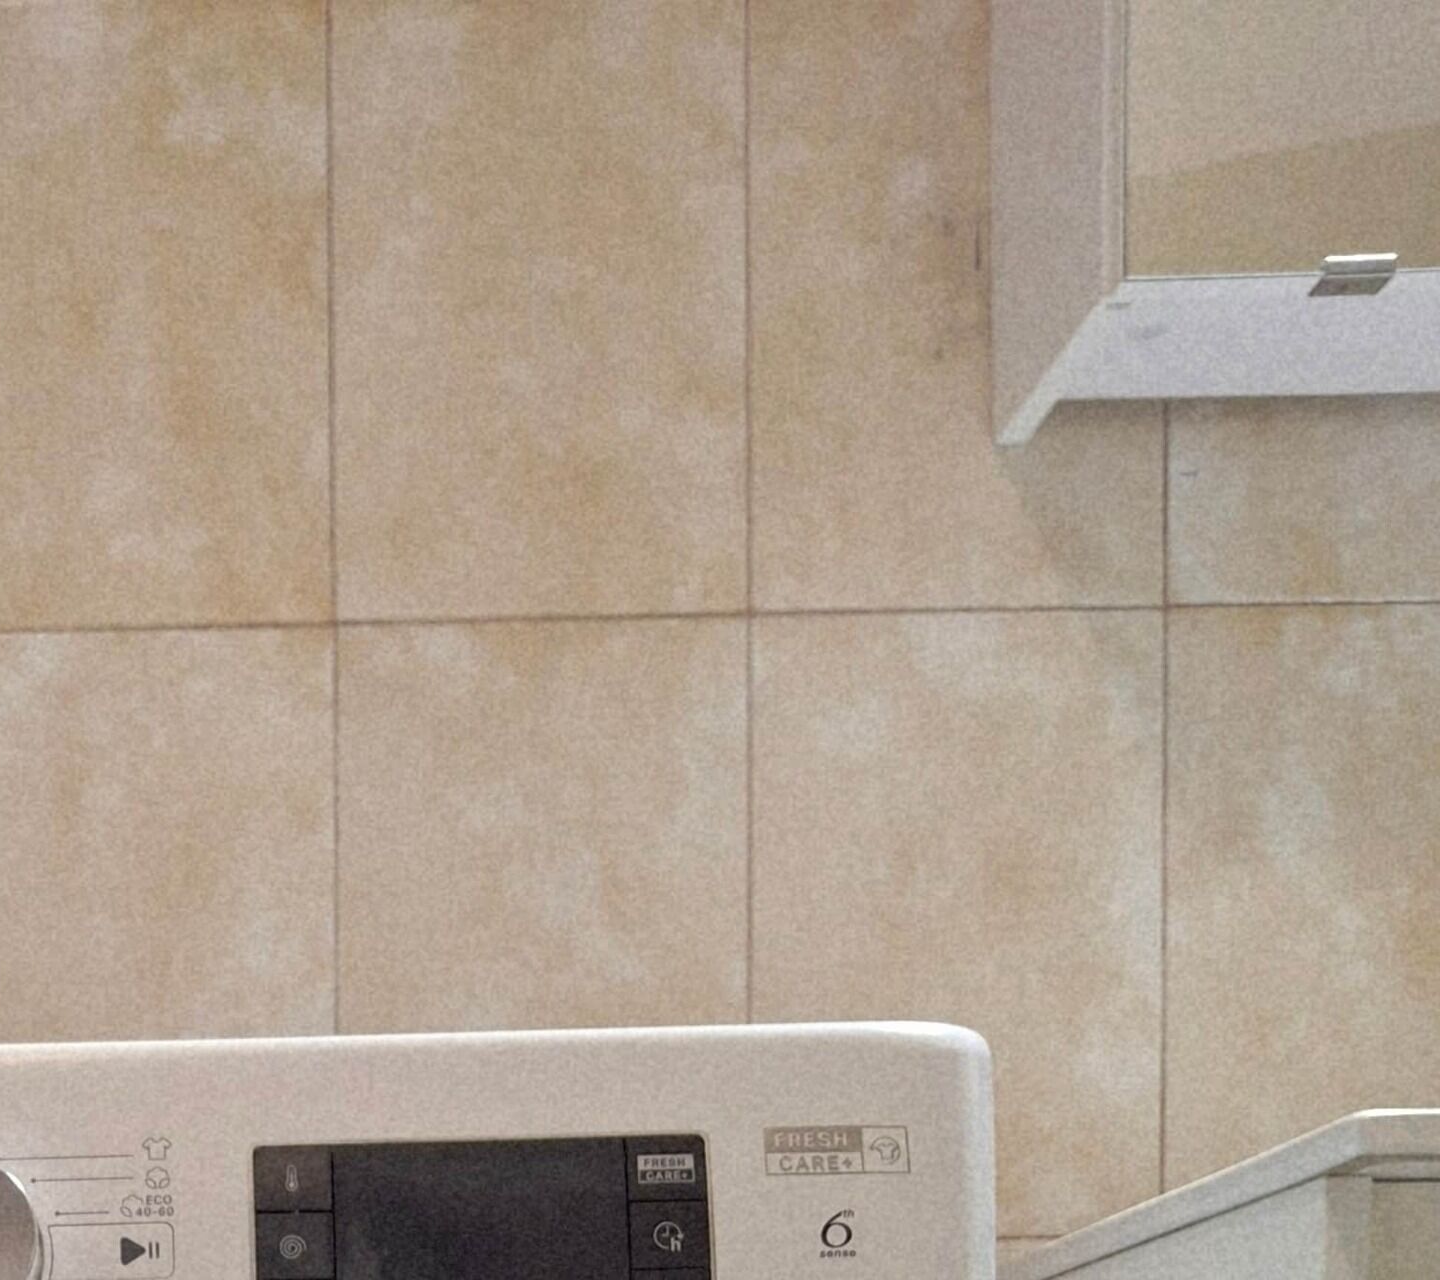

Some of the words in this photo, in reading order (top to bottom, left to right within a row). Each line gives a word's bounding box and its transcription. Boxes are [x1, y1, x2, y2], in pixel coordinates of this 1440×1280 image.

[773, 1131, 848, 1147] FRESH
[643, 1157, 686, 1168] FRESH
[778, 1154, 853, 1172] CARE+
[645, 1170, 689, 1182] CARE+
[146, 1194, 173, 1206] ECO
[135, 1206, 175, 1217] 40-60
[819, 1249, 857, 1259] sense
